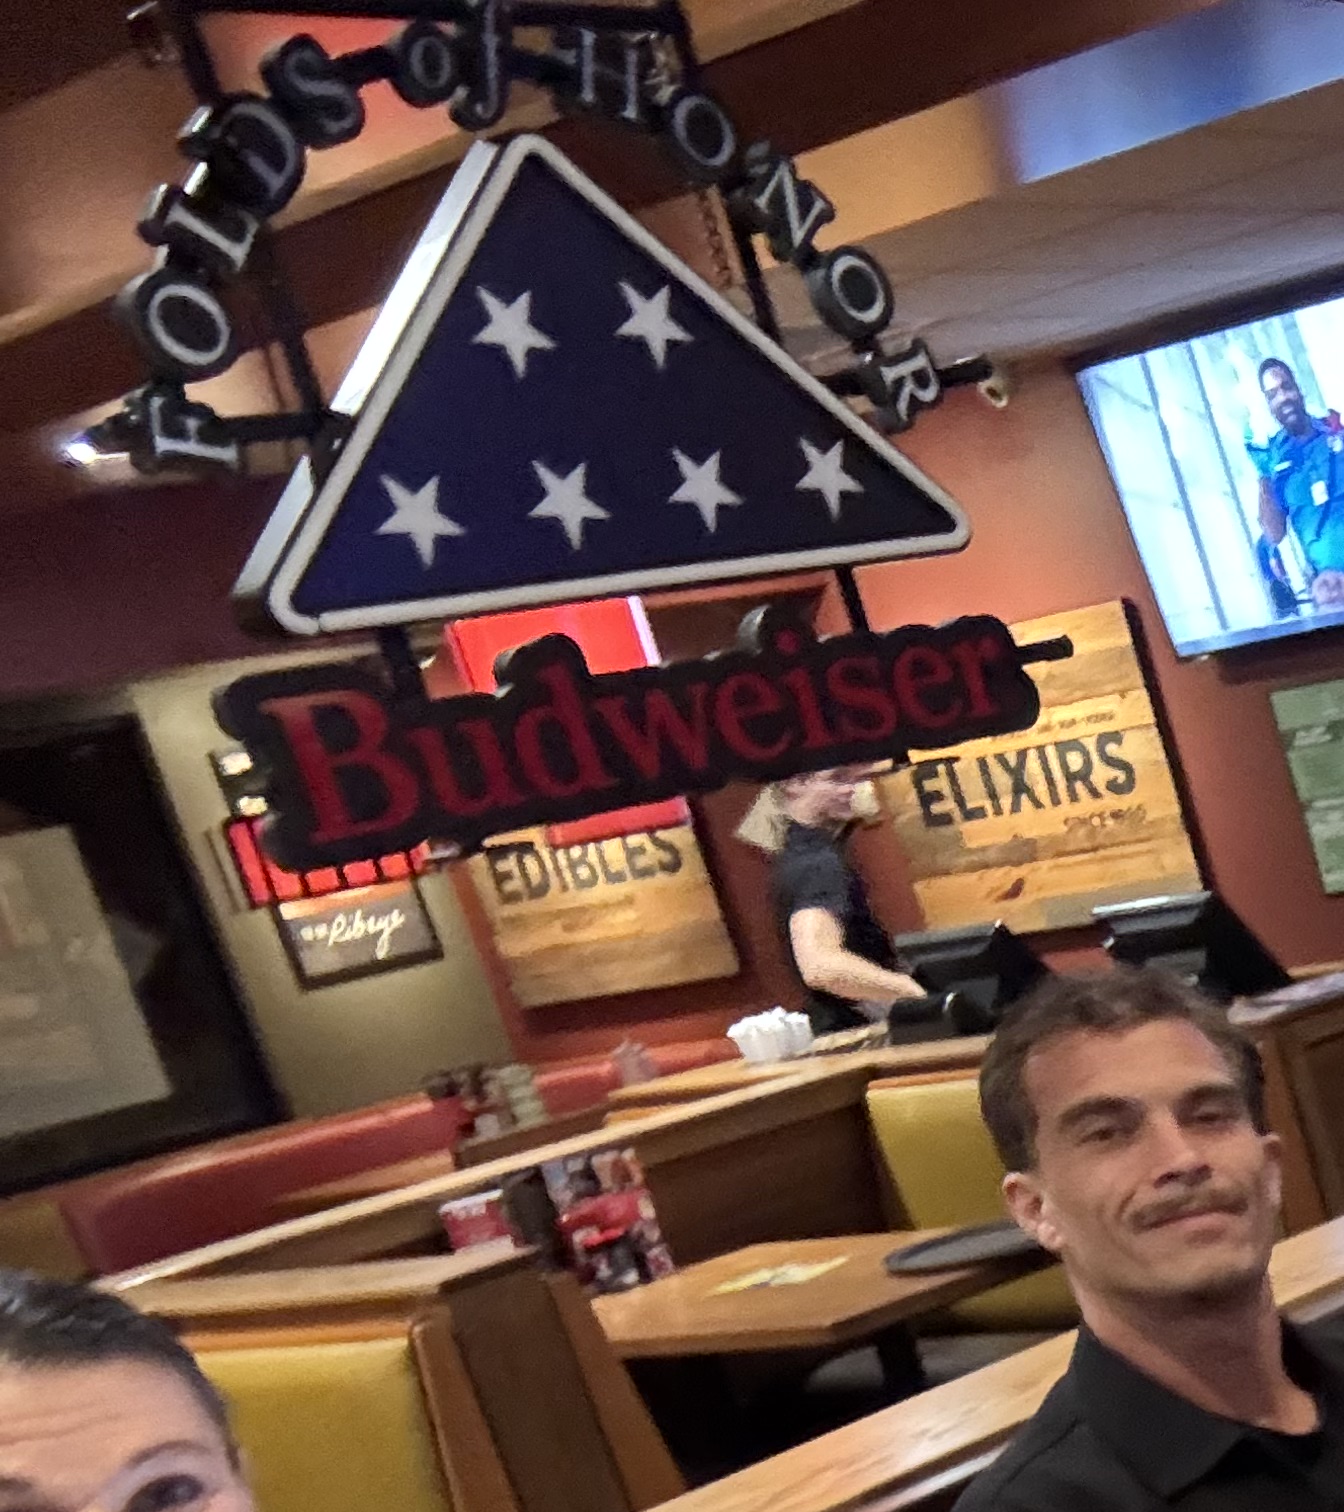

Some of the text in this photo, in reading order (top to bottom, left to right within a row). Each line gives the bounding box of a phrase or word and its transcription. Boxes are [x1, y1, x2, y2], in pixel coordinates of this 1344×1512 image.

[148, 46, 358, 464] FOLDS
[578, 27, 942, 422] HONOR
[260, 629, 998, 843] Budweiser
[911, 730, 1136, 827] ELIXIRS
[486, 832, 683, 905] EDIBLES
